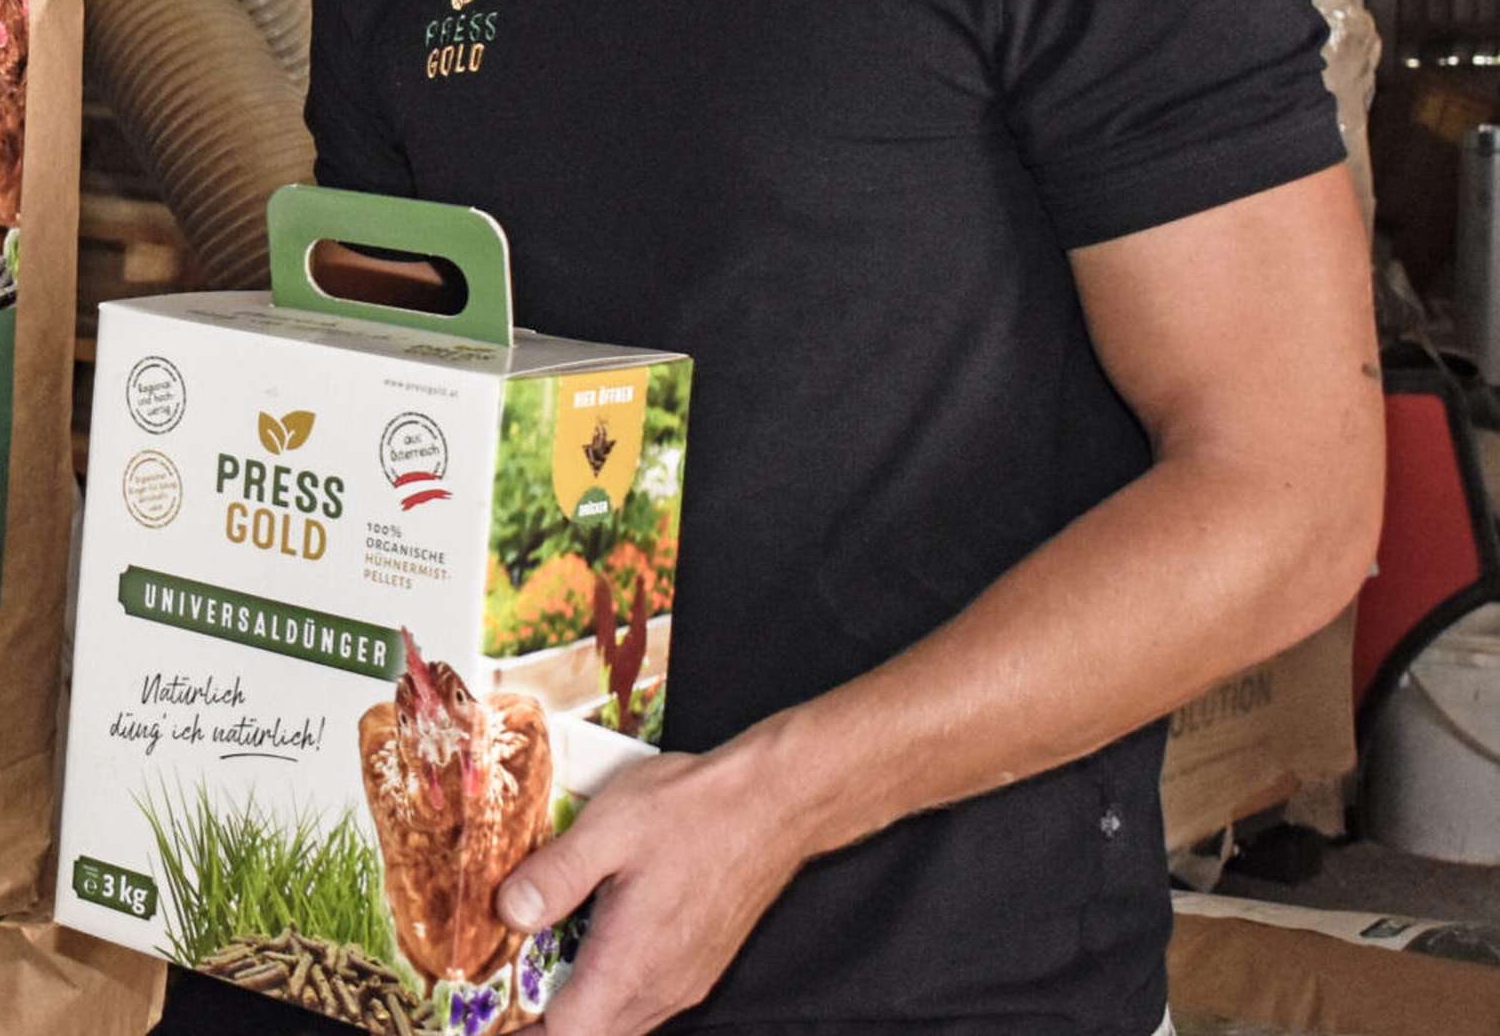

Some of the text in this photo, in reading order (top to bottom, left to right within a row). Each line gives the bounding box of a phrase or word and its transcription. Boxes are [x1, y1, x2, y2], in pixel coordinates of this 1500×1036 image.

[425, 12, 498, 47] PRESS
[427, 43, 485, 78] GOLD
[217, 453, 344, 519] PRESS
[226, 502, 327, 561] GOLD
[366, 521, 402, 538] 100%
[366, 537, 445, 564] ORGANISCHE
[363, 568, 412, 589] PELLETS
[144, 583, 386, 667] UNIVERSALDÜNGER
[141, 672, 246, 708] Natürlich
[109, 712, 326, 756] düng' ich natürlich!
[102, 874, 115, 898] 3
[119, 875, 148, 915] kg
